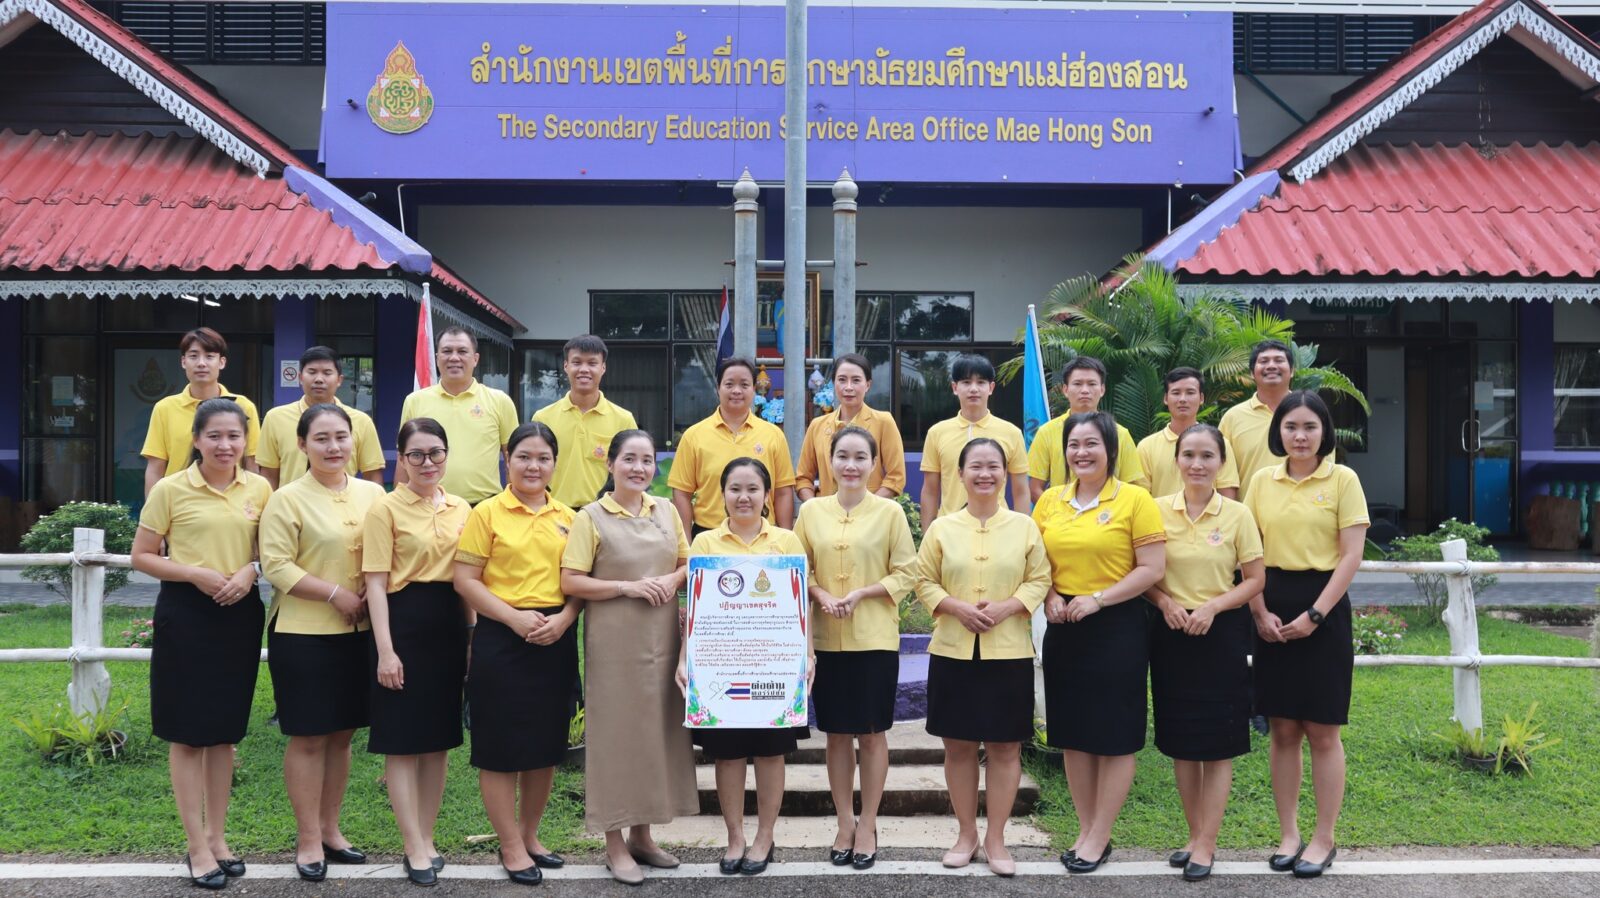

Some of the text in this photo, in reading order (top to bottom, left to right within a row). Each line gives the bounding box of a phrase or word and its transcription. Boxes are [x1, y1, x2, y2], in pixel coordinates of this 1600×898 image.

[471, 31, 1188, 89] สำนักงานเขตพื้นที่การกษามัธยมศึกษาแม่ฮ่องสอน
[498, 113, 1152, 149] The Secondary Education Srvice Area Office Mae Hong Son
